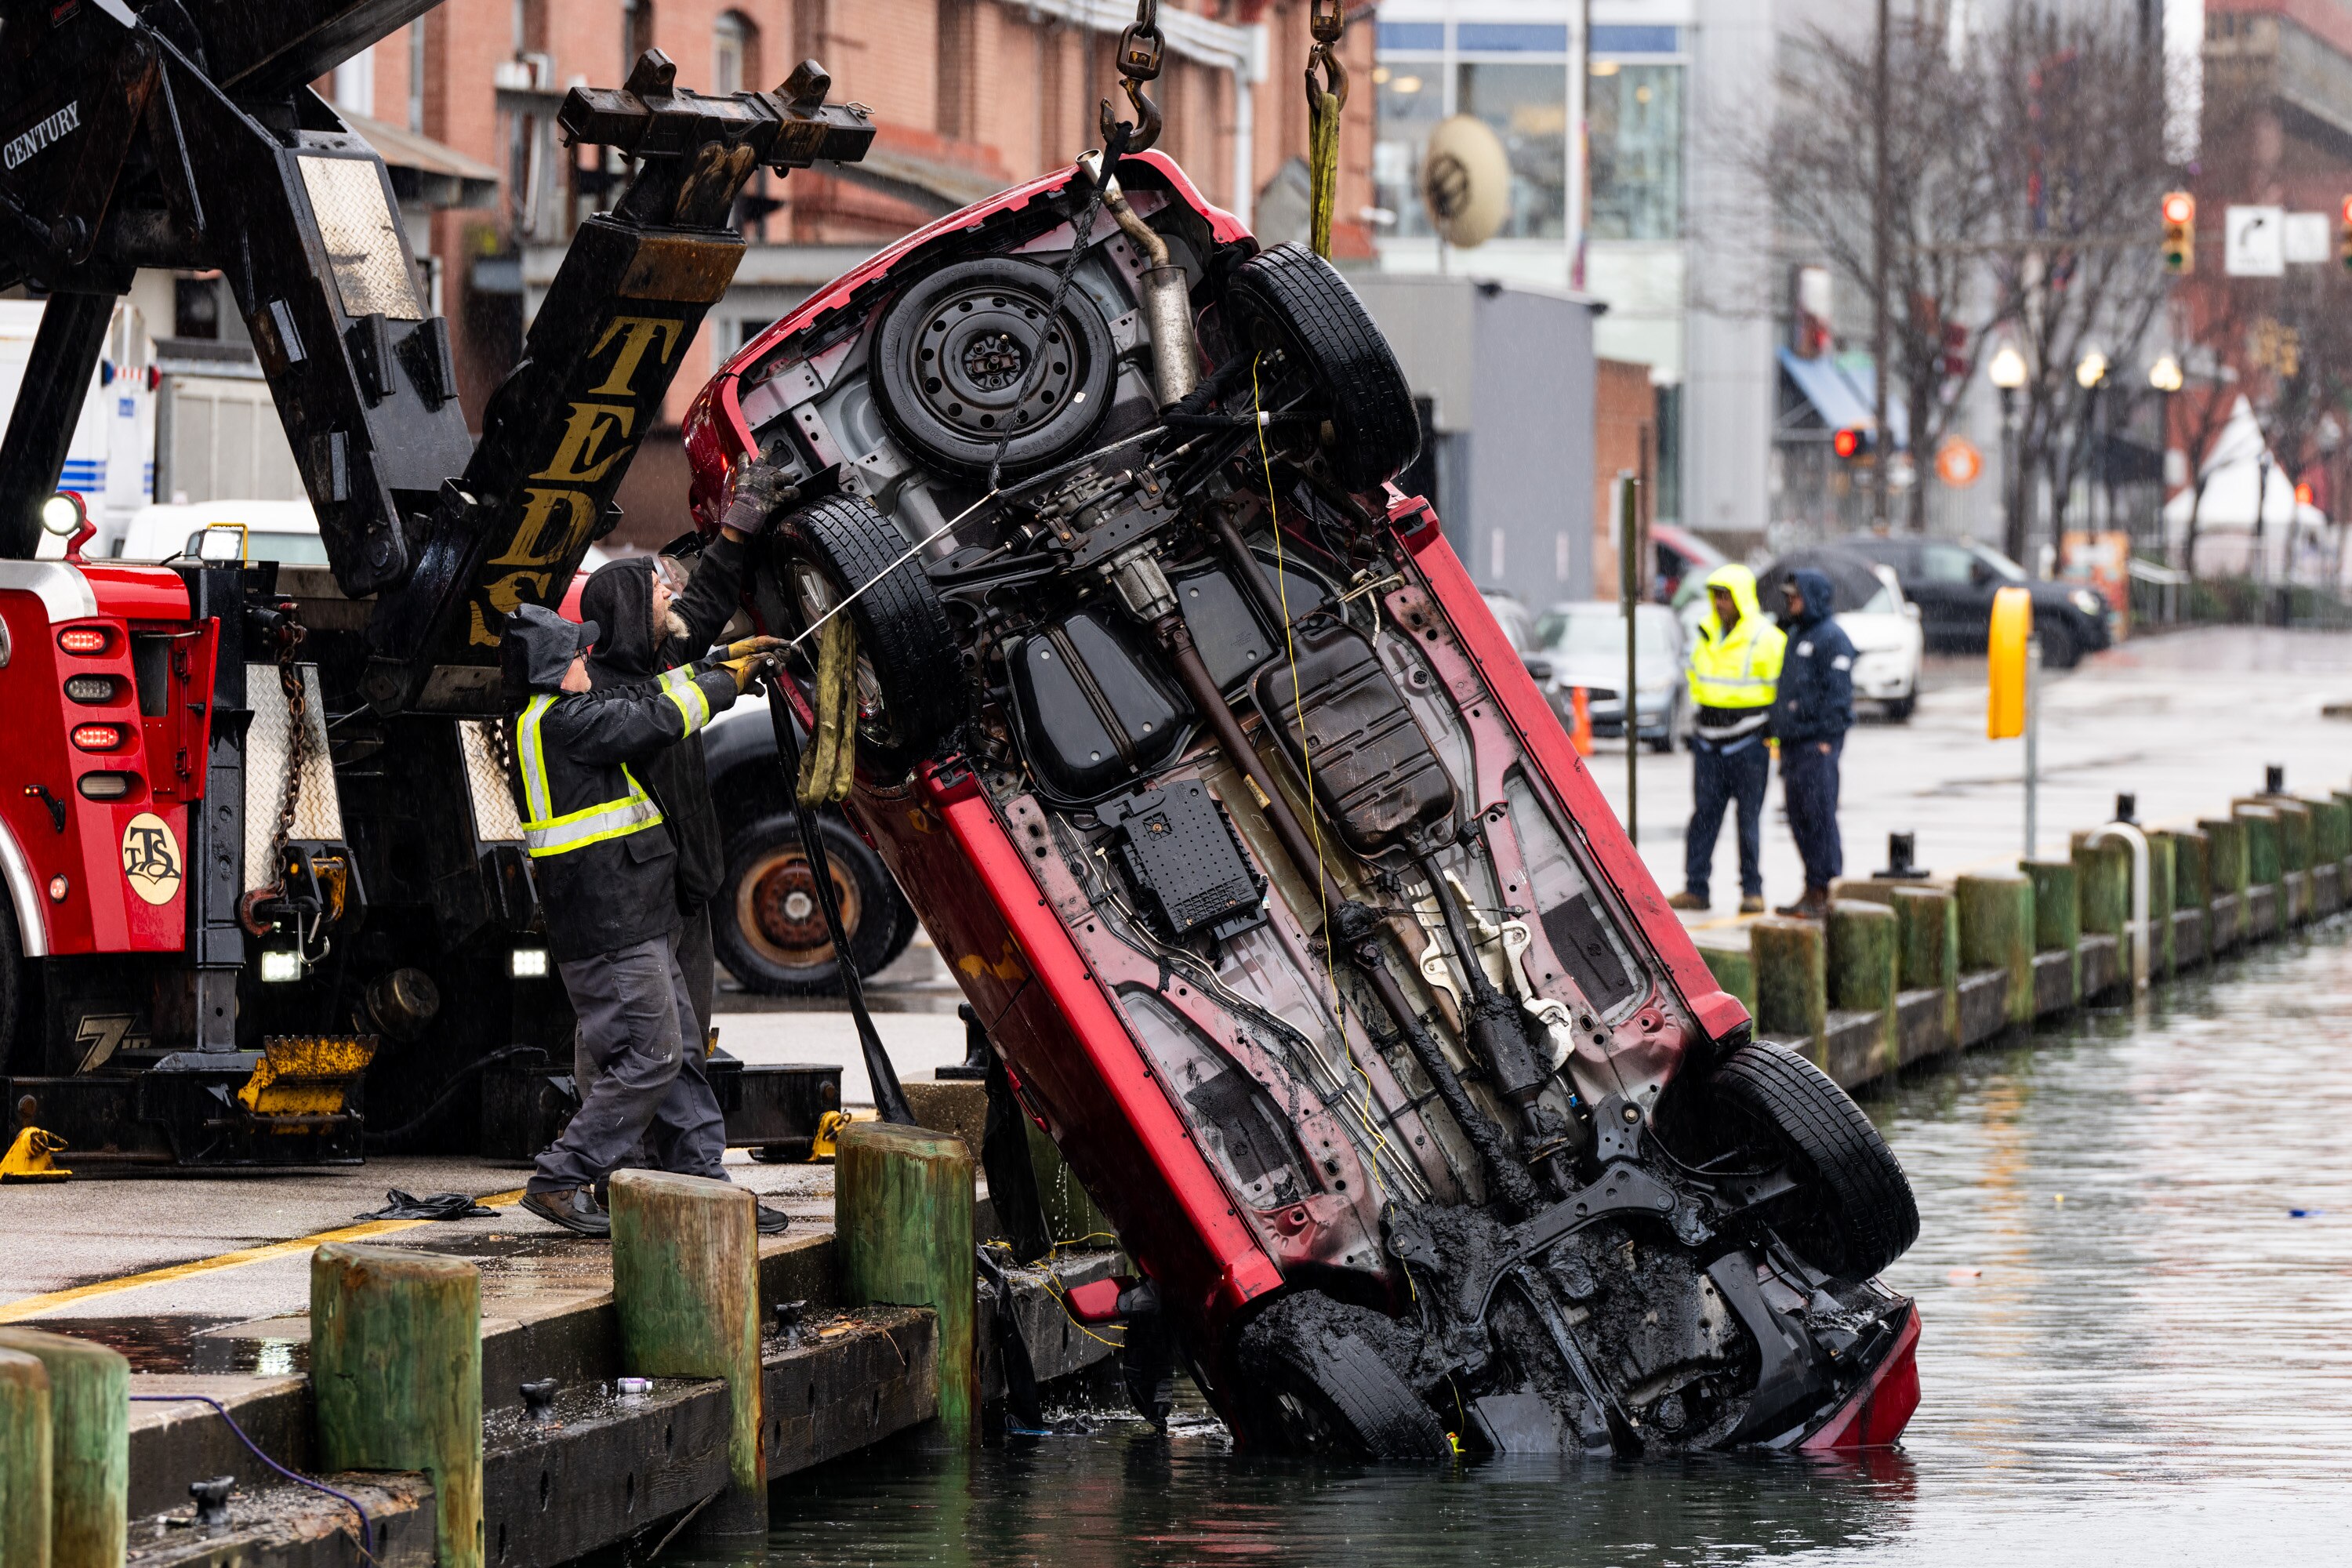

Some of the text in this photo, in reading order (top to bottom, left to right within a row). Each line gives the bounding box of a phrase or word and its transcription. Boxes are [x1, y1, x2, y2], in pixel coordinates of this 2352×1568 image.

[3, 100, 81, 170] CENTURY
[978, 263, 995, 271] USE
[996, 263, 1018, 272] ONLY
[1021, 421, 1076, 455] KUMHO
